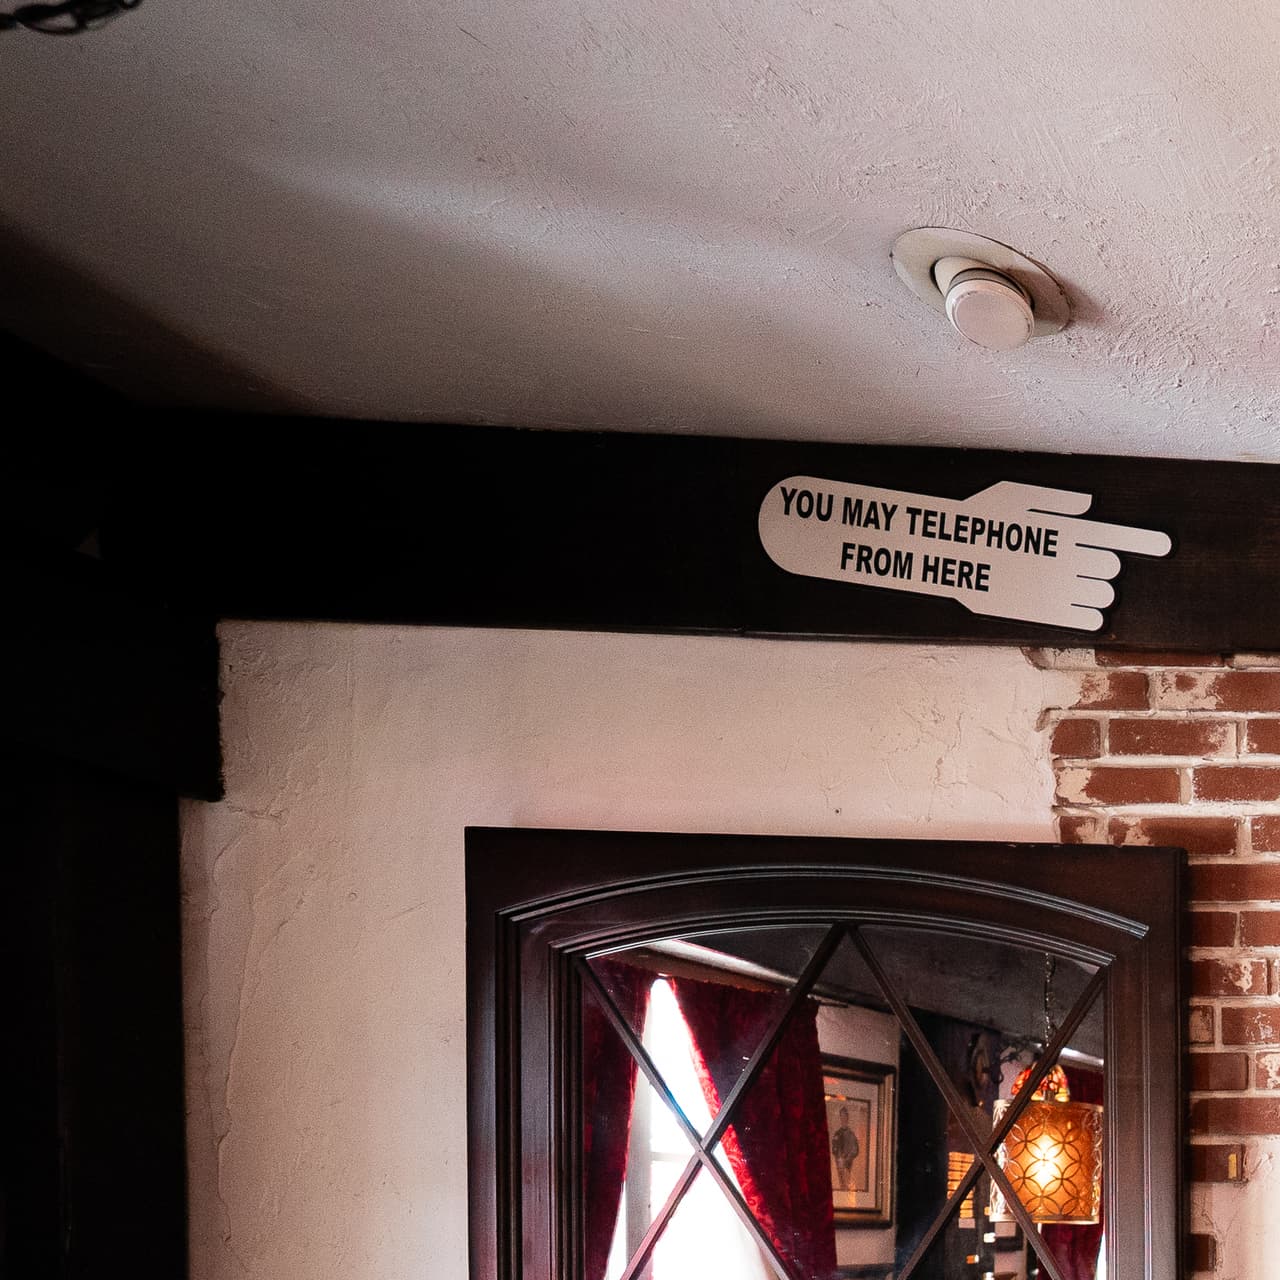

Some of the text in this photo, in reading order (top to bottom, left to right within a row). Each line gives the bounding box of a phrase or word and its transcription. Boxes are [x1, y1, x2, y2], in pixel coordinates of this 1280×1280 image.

[779, 485, 1059, 557] YOU MAY TELEPHONE
[840, 542, 991, 592] FROM HERE
